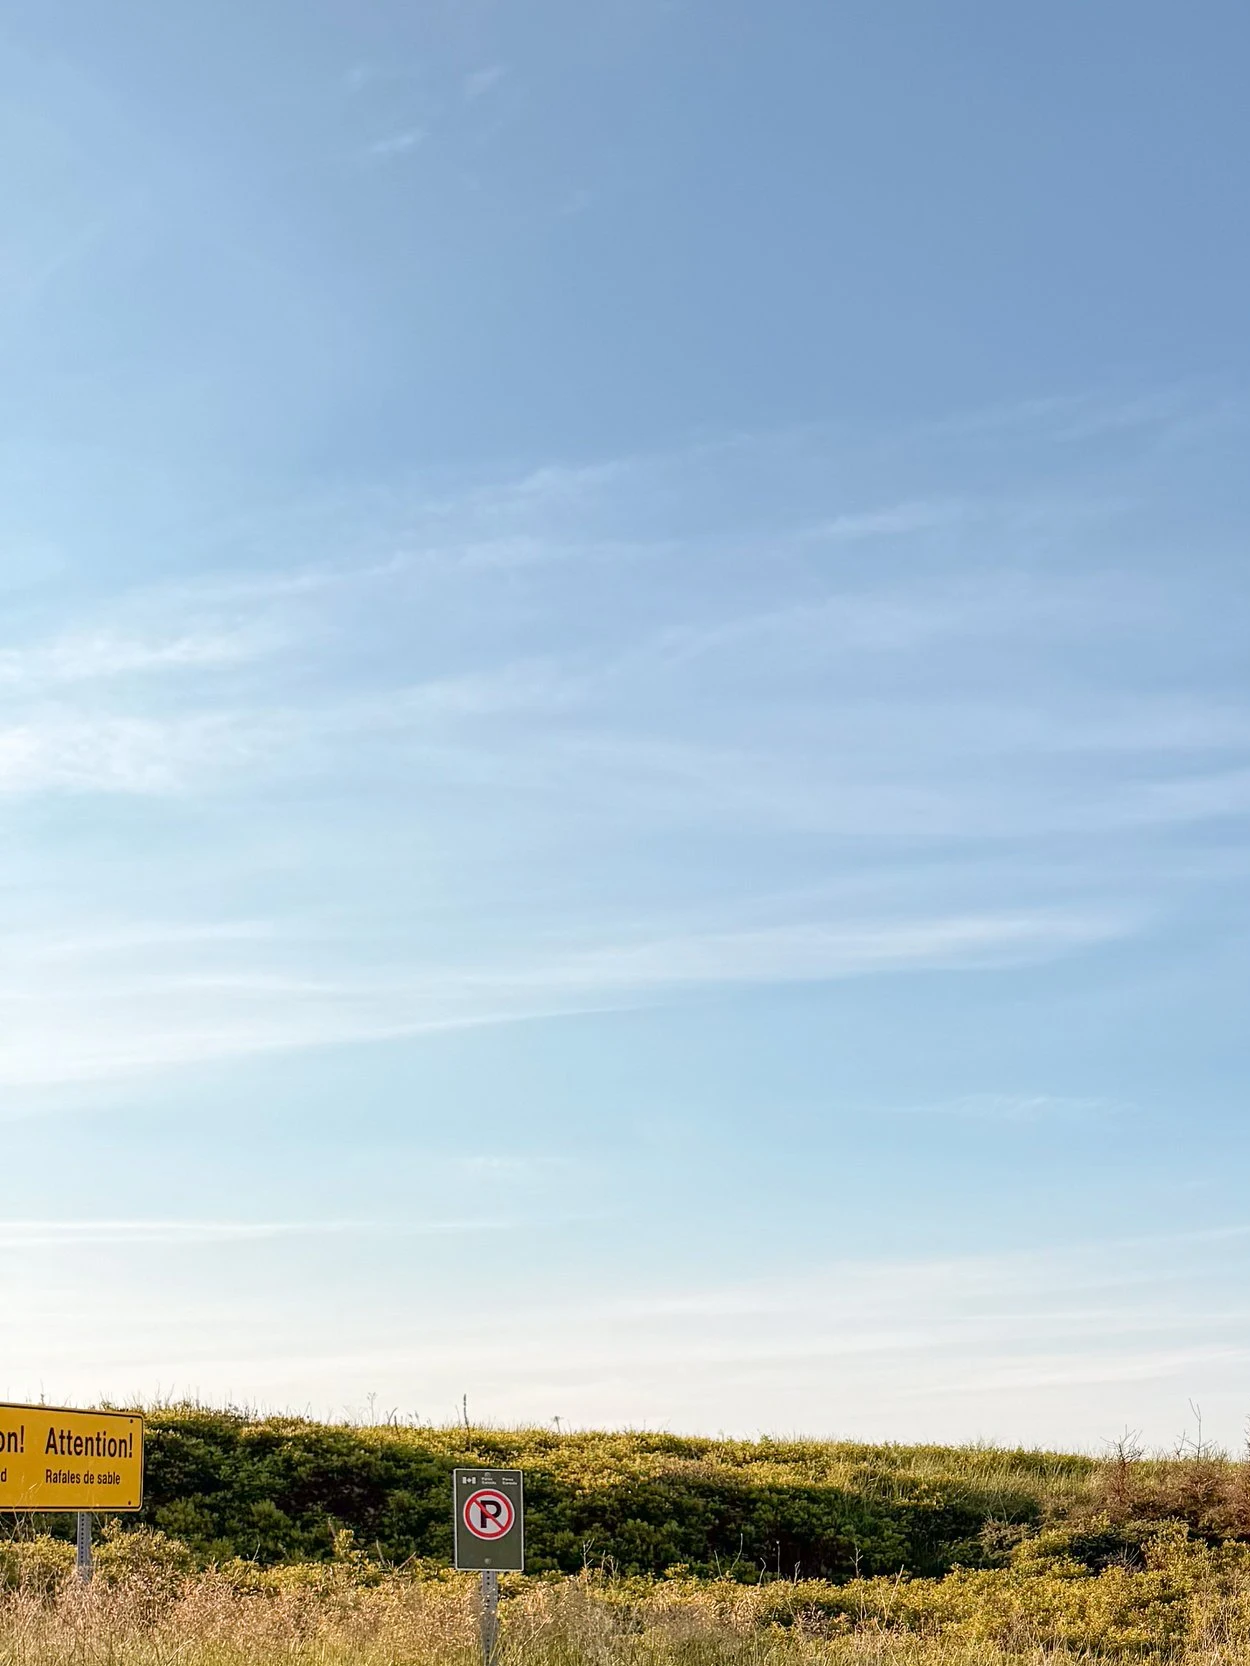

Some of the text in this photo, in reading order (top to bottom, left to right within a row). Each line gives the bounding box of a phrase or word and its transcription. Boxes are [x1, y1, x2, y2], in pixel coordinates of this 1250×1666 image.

[45, 1427, 133, 1458] Attention!
[45, 1469, 121, 1485] Rafales de sable
[480, 1500, 502, 1528] P
